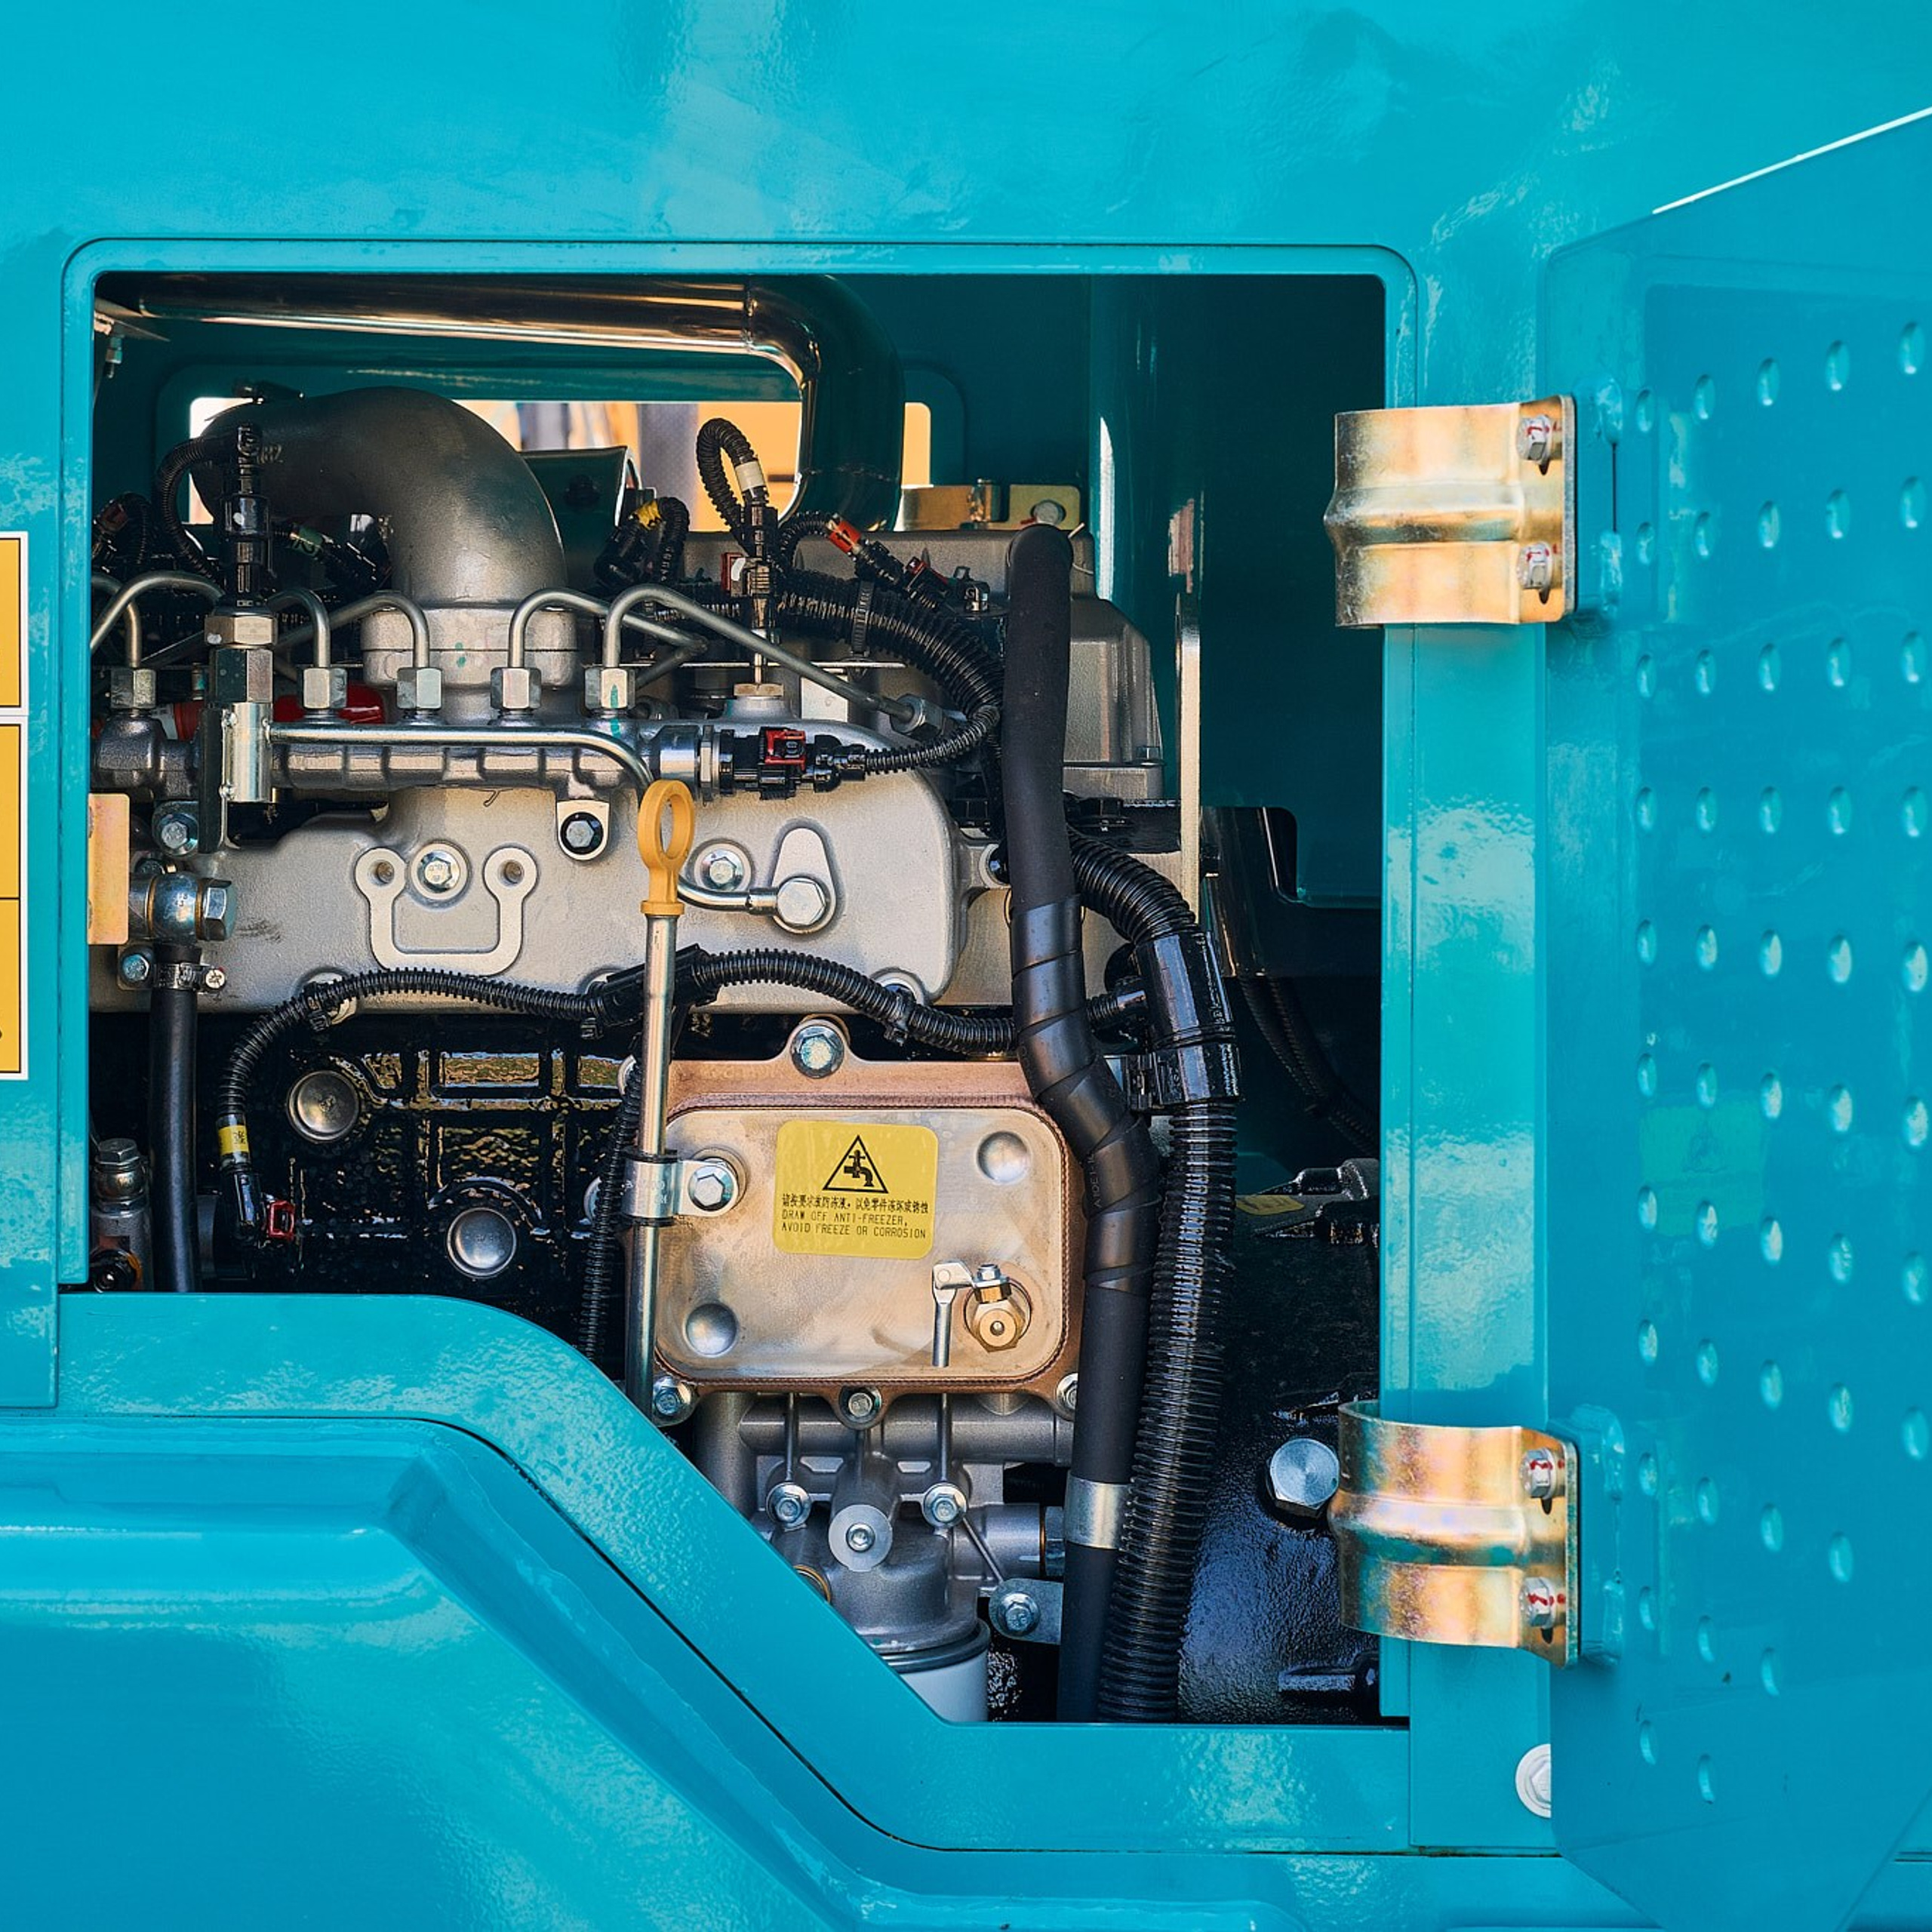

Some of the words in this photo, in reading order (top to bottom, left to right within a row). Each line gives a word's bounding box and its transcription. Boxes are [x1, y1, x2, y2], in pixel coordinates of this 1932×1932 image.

[782, 1209, 804, 1220] DRAW
[811, 1211, 828, 1221] OFF
[782, 1222, 811, 1232] AVOID
[816, 1223, 851, 1235] FREEZE
[857, 1226, 867, 1235] OR
[874, 1226, 925, 1238] CORROSION
